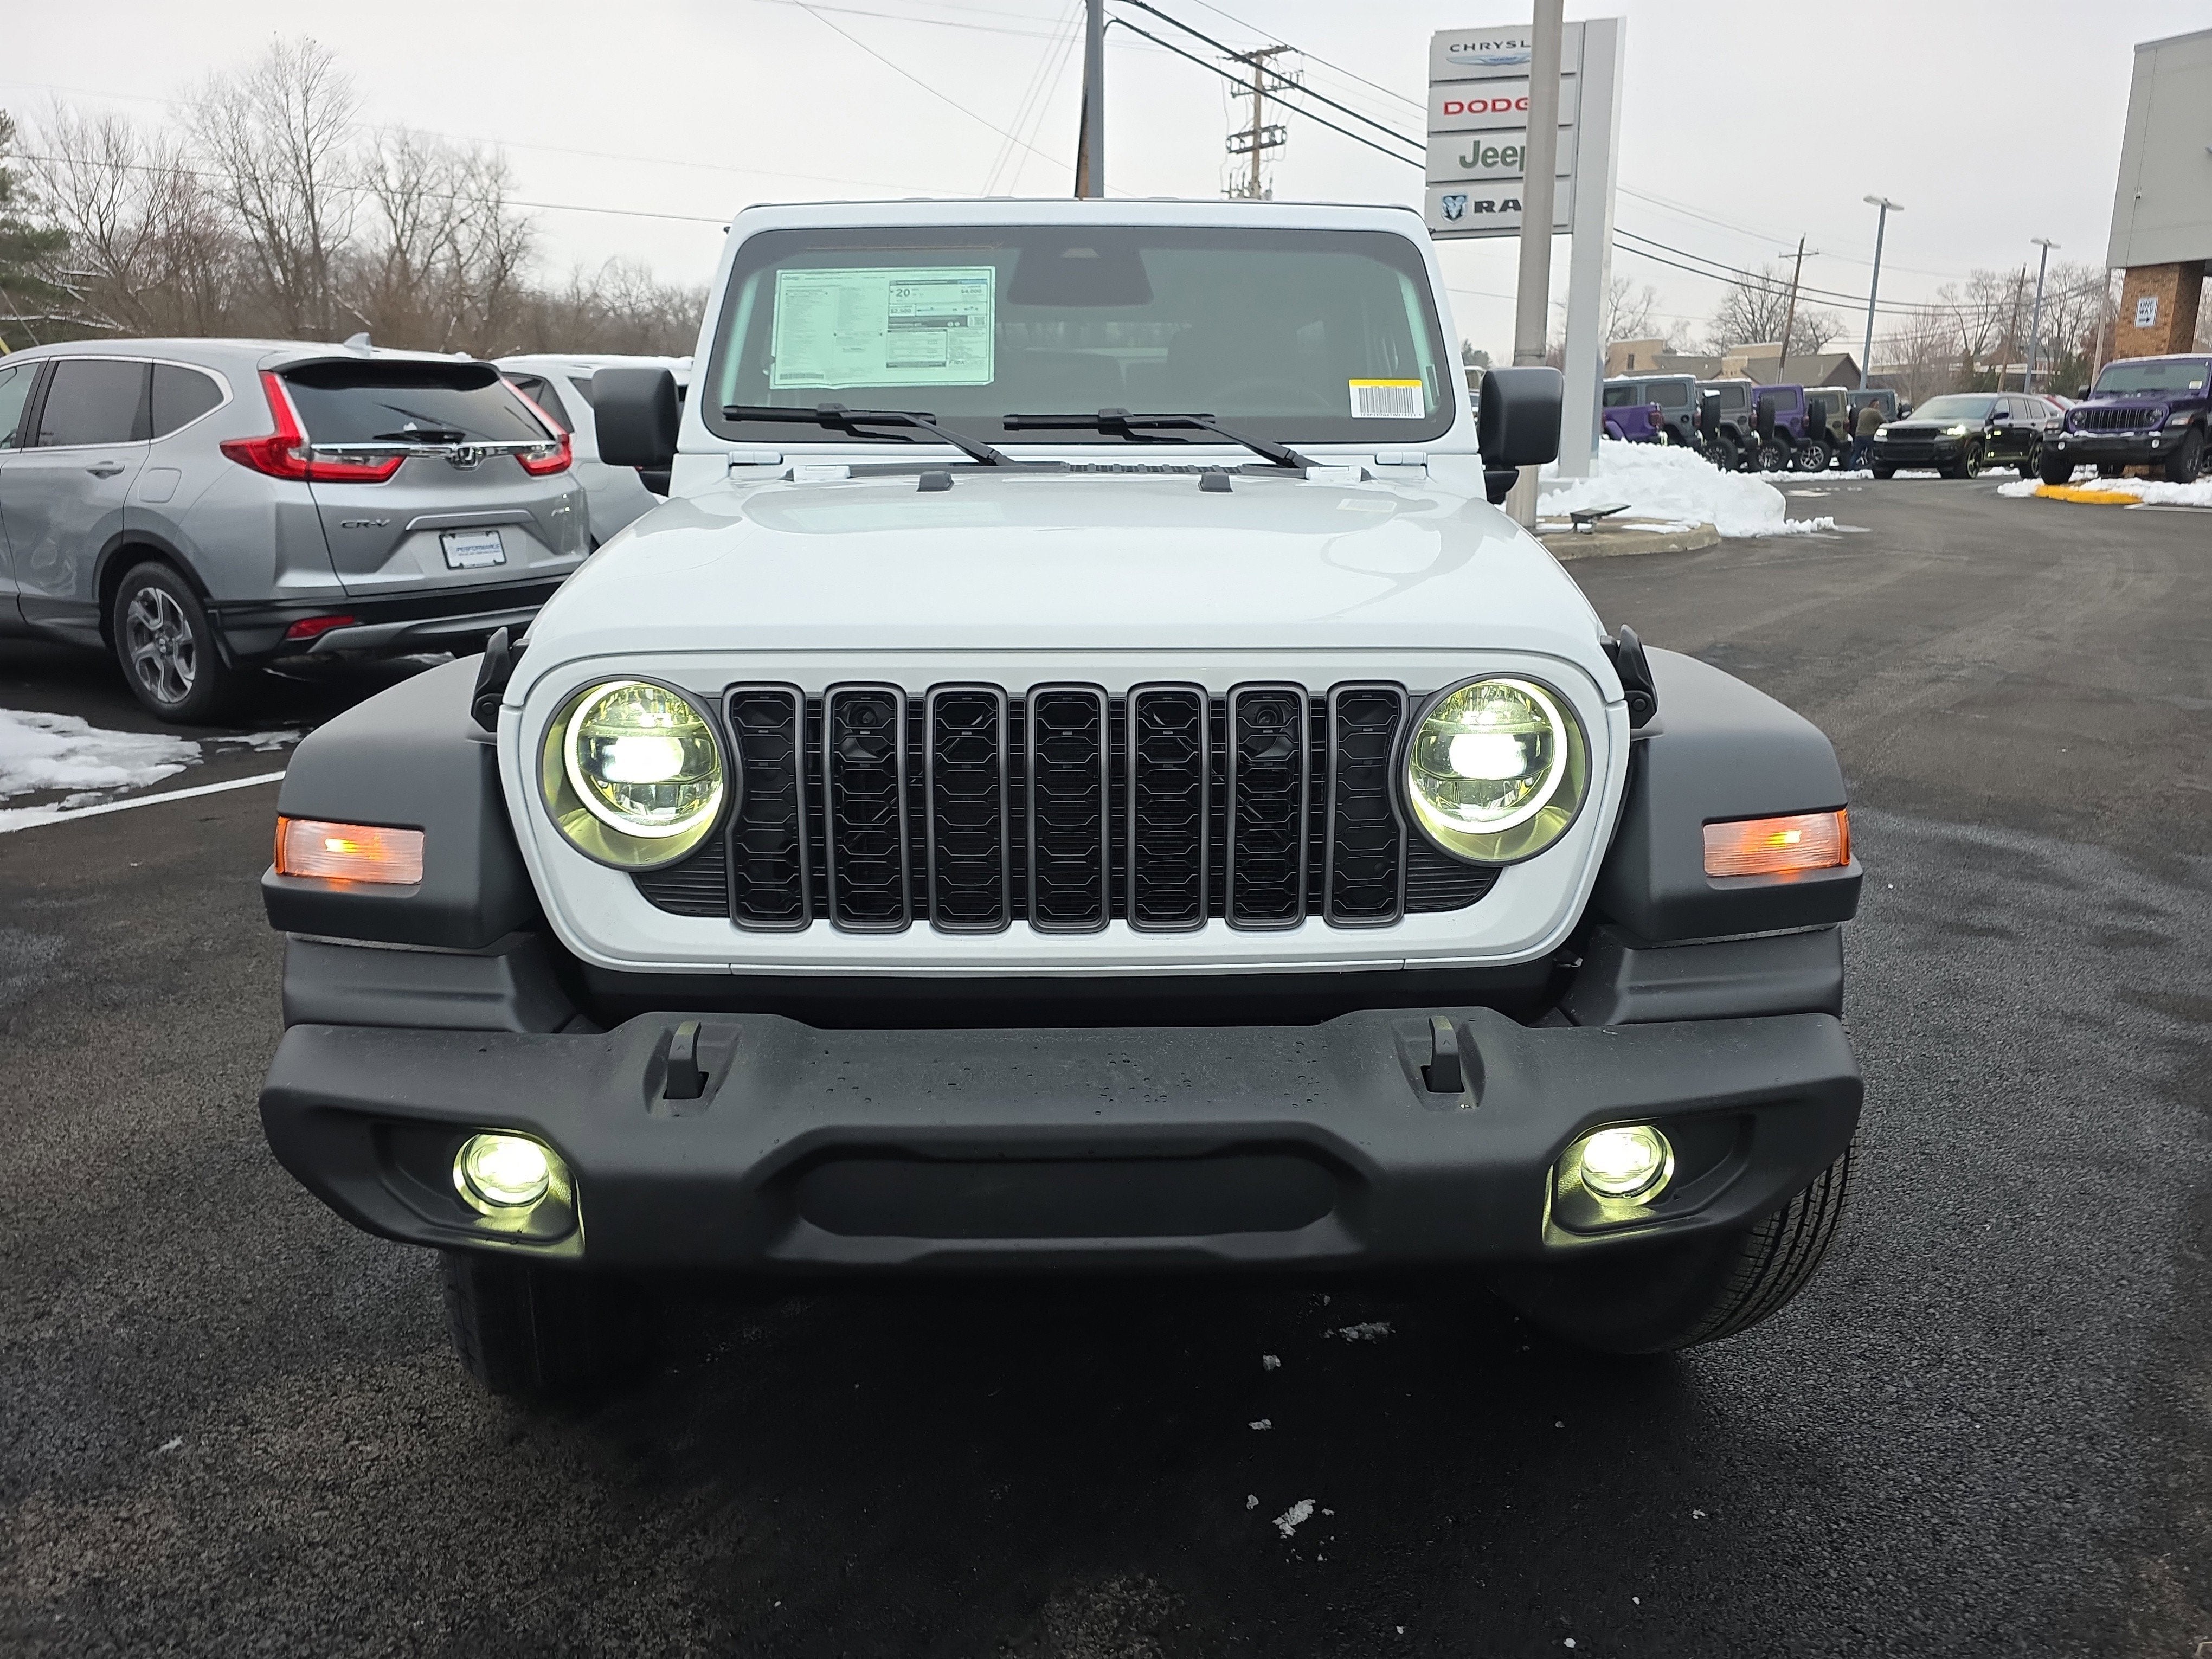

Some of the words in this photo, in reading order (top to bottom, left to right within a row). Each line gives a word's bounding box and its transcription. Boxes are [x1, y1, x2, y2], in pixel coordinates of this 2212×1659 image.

[1450, 40, 1531, 52] CHRYSL
[1443, 98, 1528, 116] DODG
[1474, 199, 1522, 213] RA
[896, 288, 910, 298] 20
[340, 518, 390, 529] CR-V
